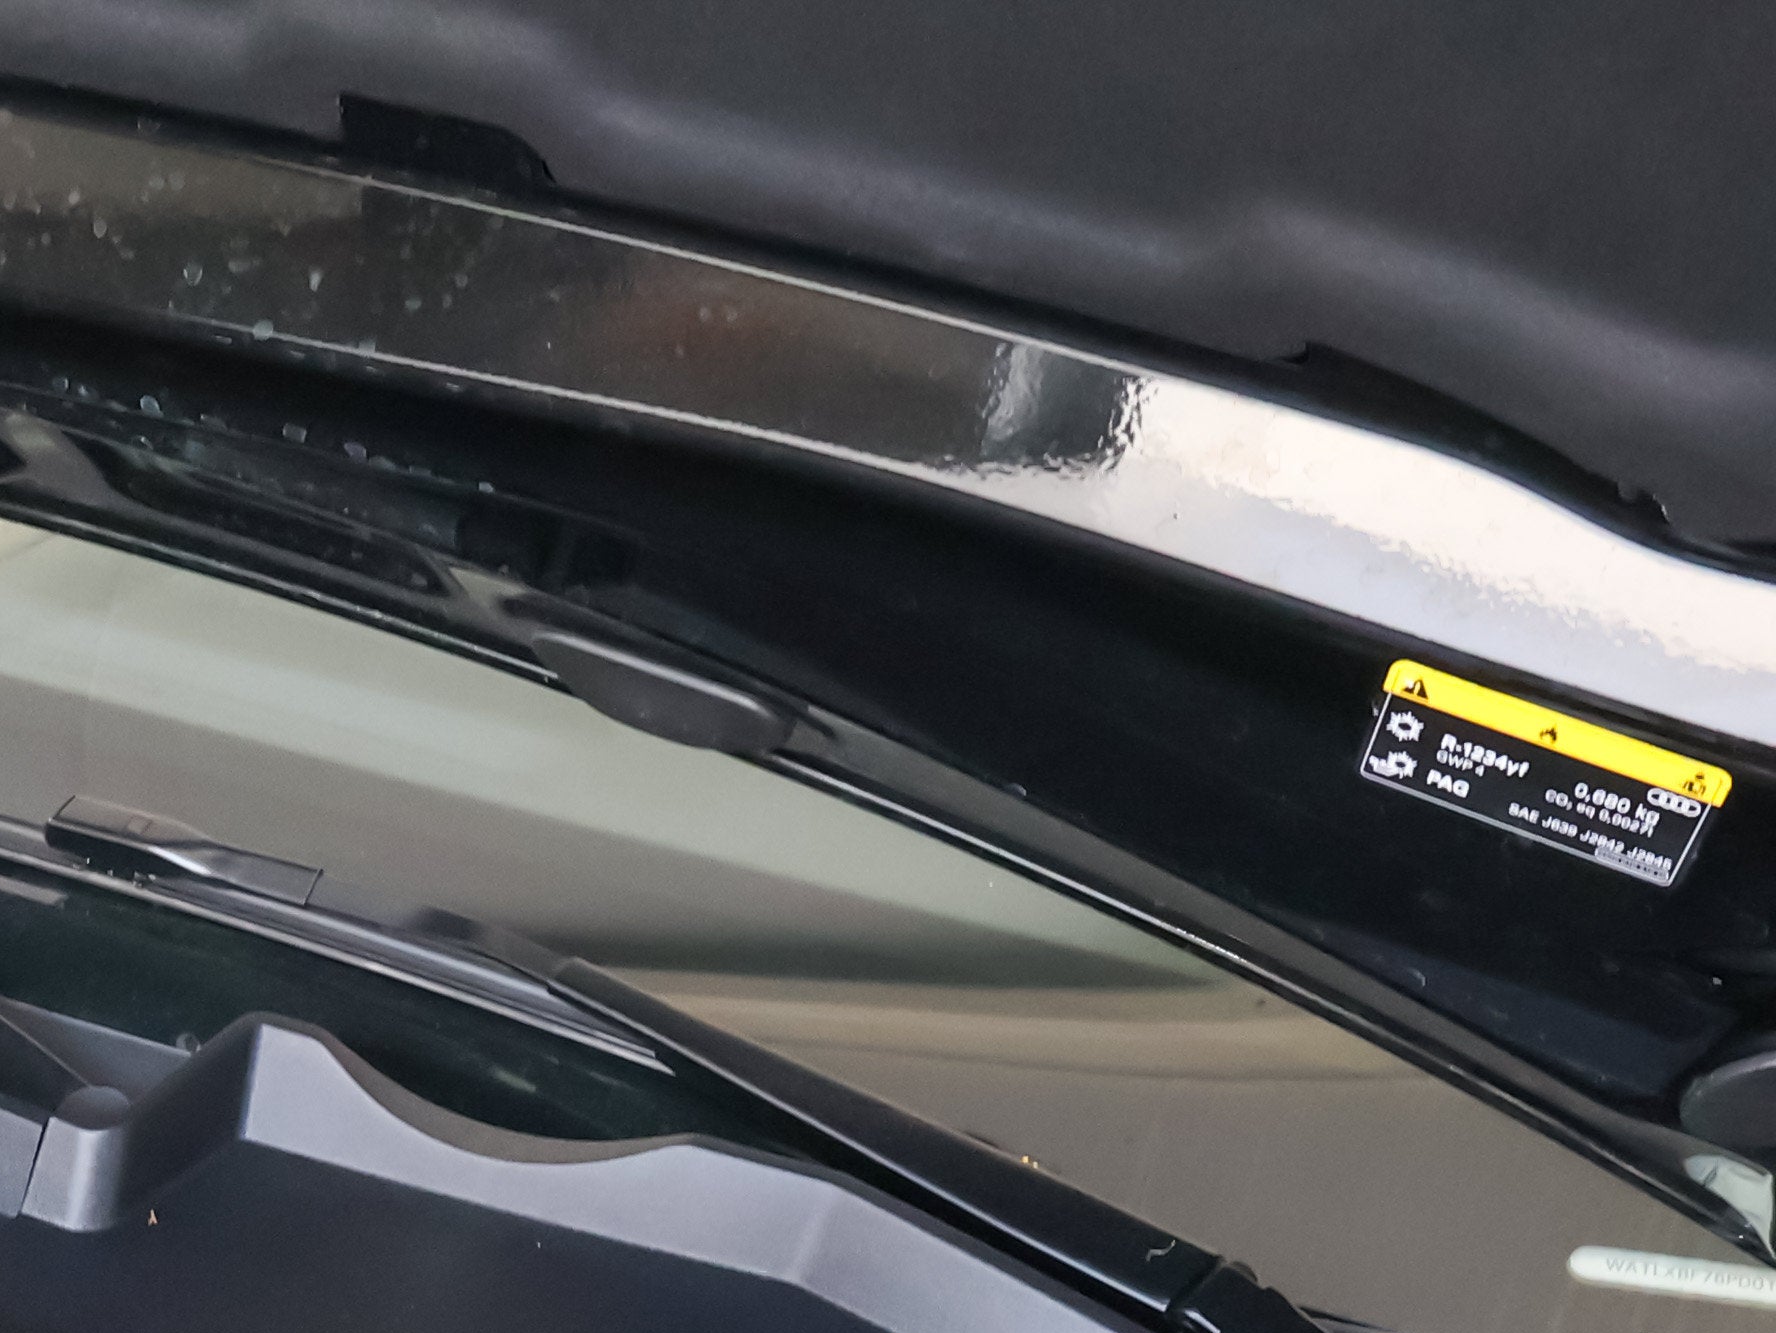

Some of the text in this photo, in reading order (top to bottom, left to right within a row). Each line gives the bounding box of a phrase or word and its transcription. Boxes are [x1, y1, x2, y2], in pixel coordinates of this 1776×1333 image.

[1437, 750, 1472, 770] GWP
[1441, 734, 1529, 777] R-1234yf
[1427, 769, 1469, 798] PAG
[1508, 803, 1539, 824] SAE
[1636, 803, 1659, 826] kg
